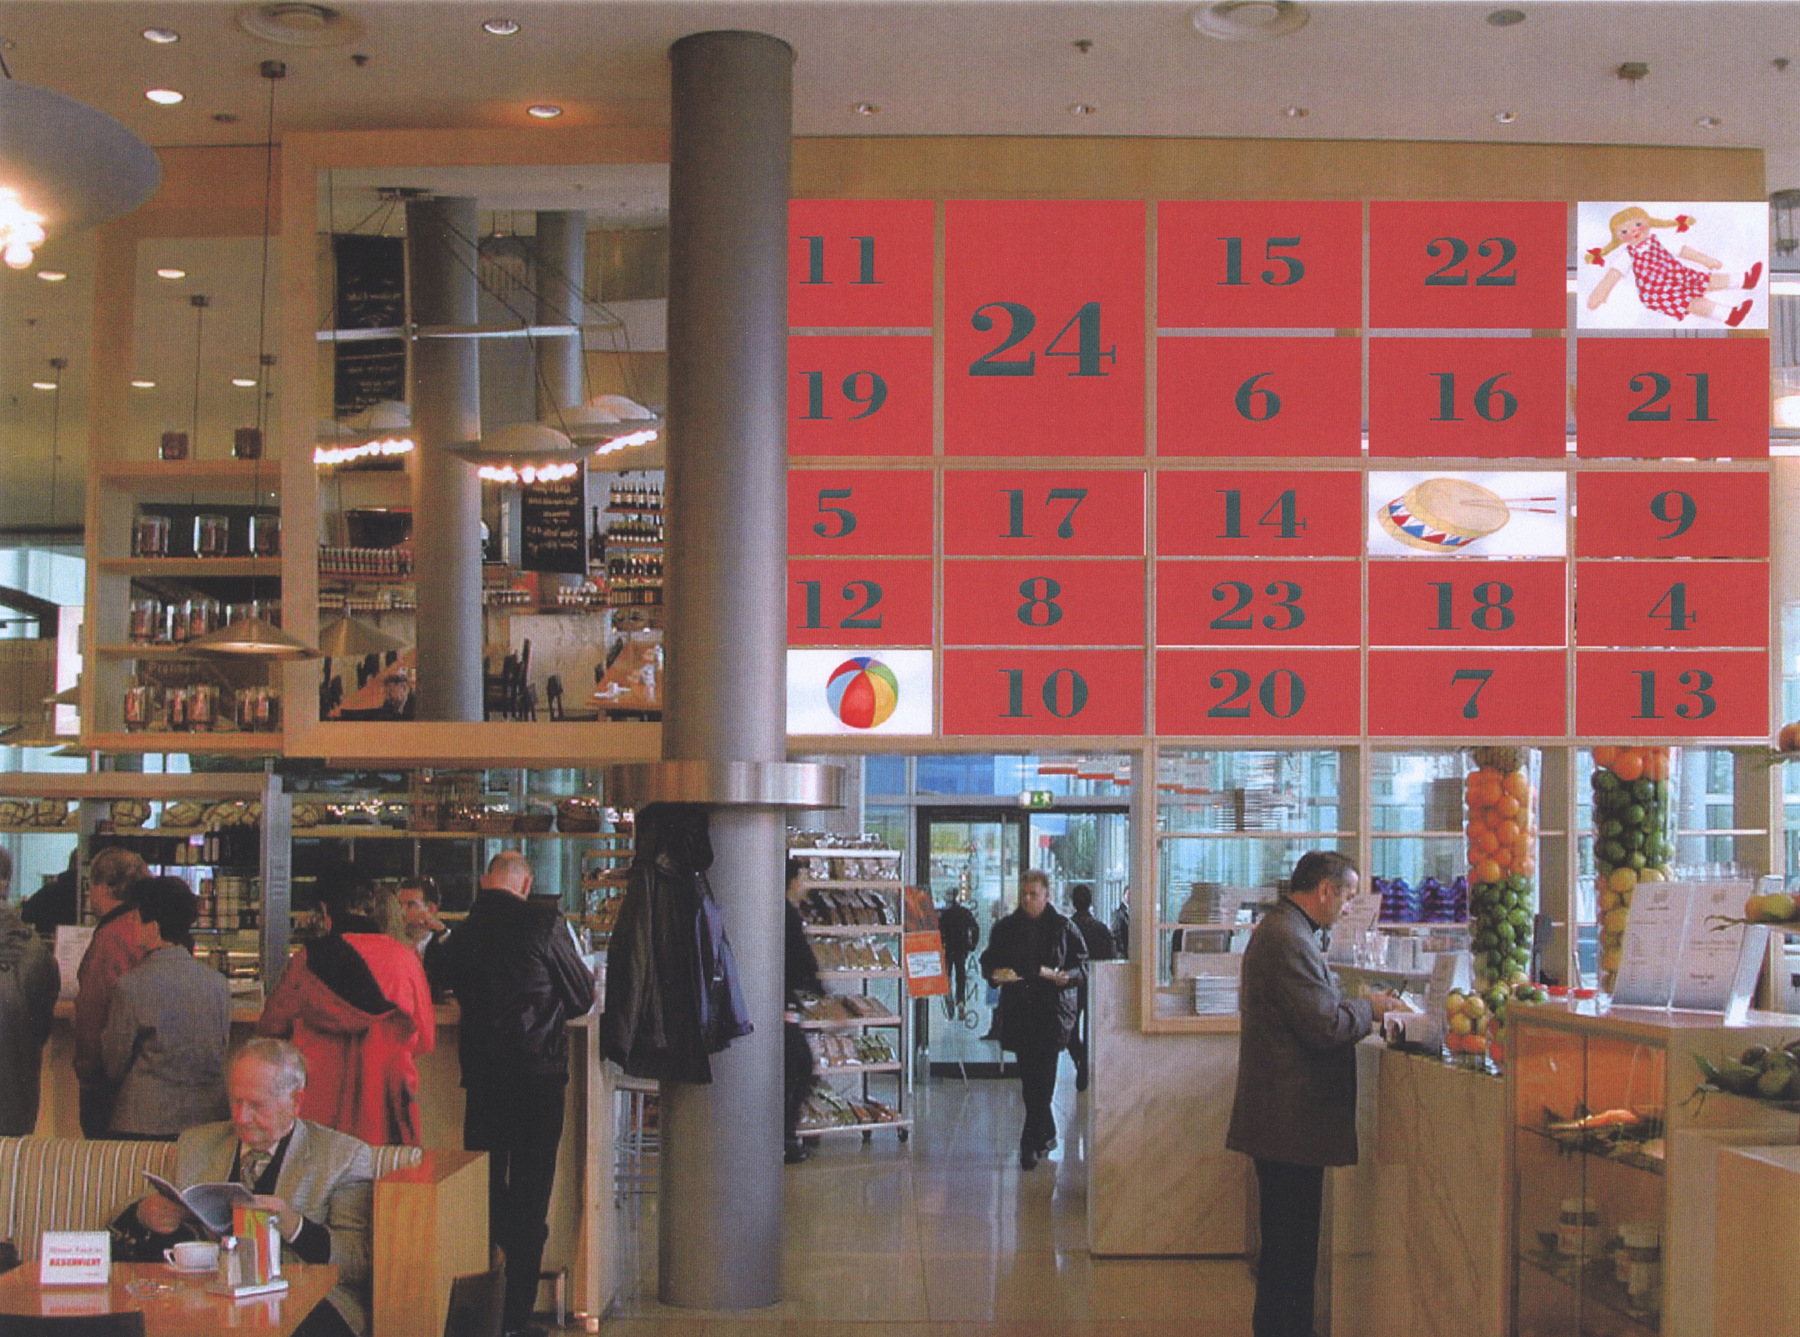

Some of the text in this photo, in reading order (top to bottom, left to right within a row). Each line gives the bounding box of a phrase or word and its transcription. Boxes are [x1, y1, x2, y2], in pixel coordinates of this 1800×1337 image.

[799, 235, 883, 285] 11
[1216, 235, 1305, 286] 15
[1424, 237, 1517, 287] 22
[968, 301, 1116, 377] 24
[798, 371, 888, 420] 19
[1234, 372, 1282, 421] 6
[1429, 372, 1519, 422] 16
[1627, 371, 1718, 422] 21
[813, 487, 857, 538] 5
[999, 488, 1088, 539] 17
[1215, 489, 1307, 539] 14
[1650, 490, 1697, 540] 9
[796, 580, 883, 629] 12
[1017, 576, 1063, 627] 8
[1209, 580, 1306, 631] 23
[1427, 581, 1515, 631] 18
[1647, 582, 1697, 631] 4
[998, 668, 1089, 718] 10
[1207, 668, 1306, 719] 20
[1450, 669, 1494, 720] 7
[1630, 669, 1717, 720] 13
